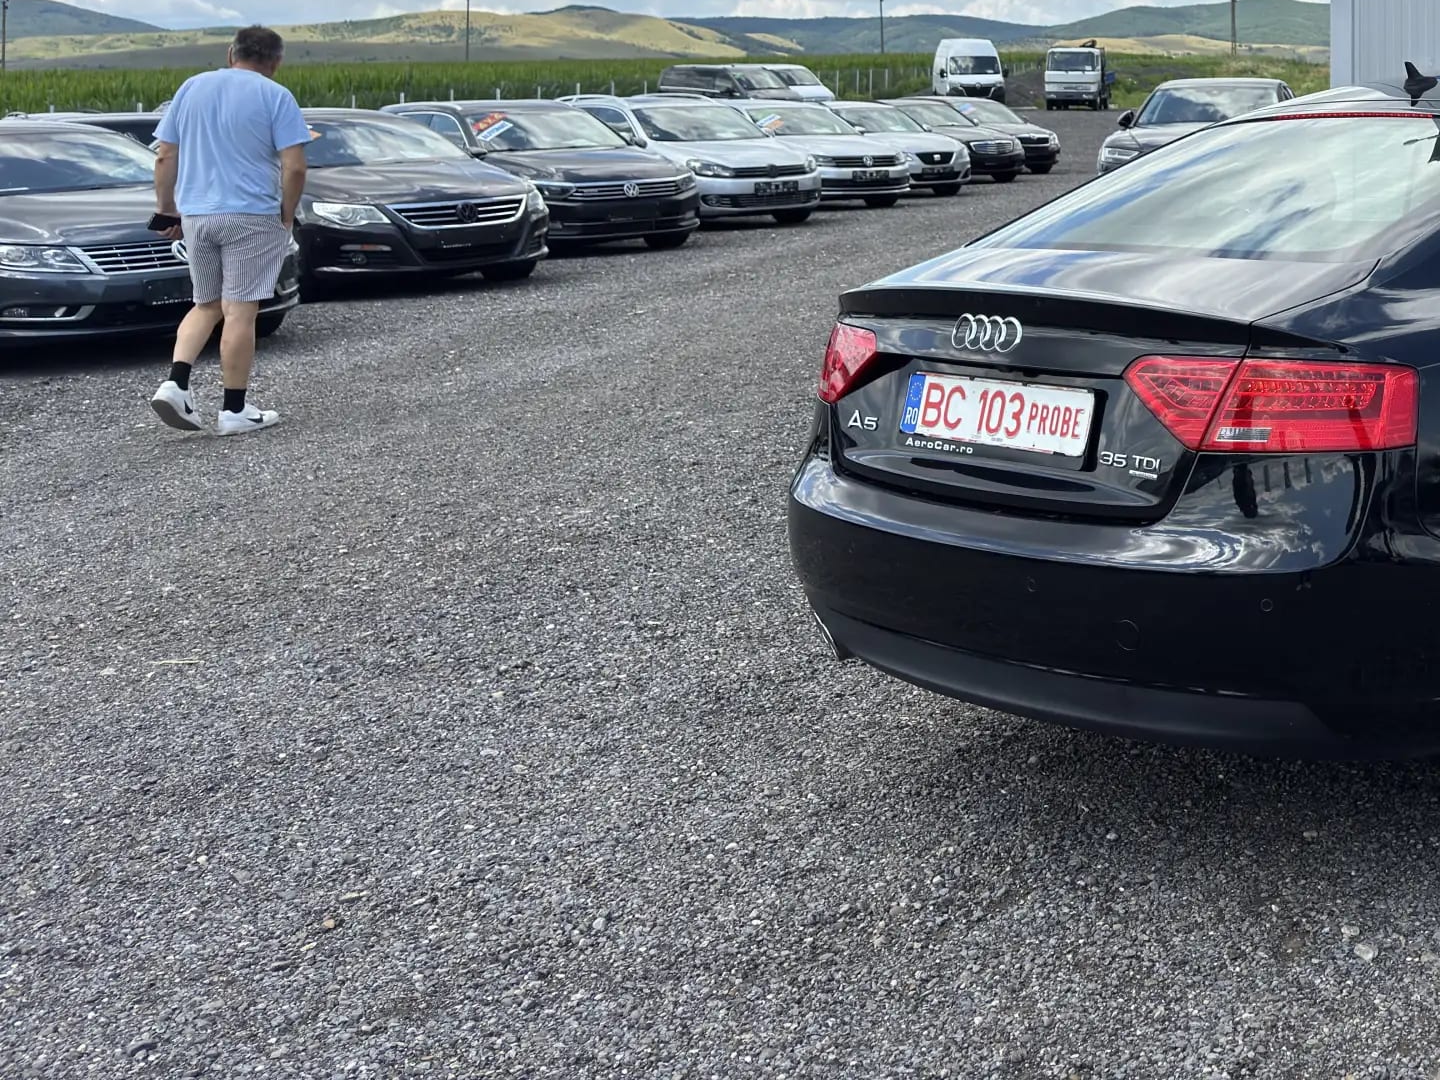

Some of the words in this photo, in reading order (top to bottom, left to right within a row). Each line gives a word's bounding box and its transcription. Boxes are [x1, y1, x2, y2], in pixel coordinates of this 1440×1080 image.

[847, 409, 879, 431] A5
[904, 406, 919, 426] RO
[920, 382, 967, 431] BC
[976, 388, 1026, 438] 103
[1026, 401, 1085, 440] PROBE
[905, 436, 974, 455] AeroCar.ro
[1099, 451, 1128, 468] 35
[1131, 454, 1161, 470] TDI
